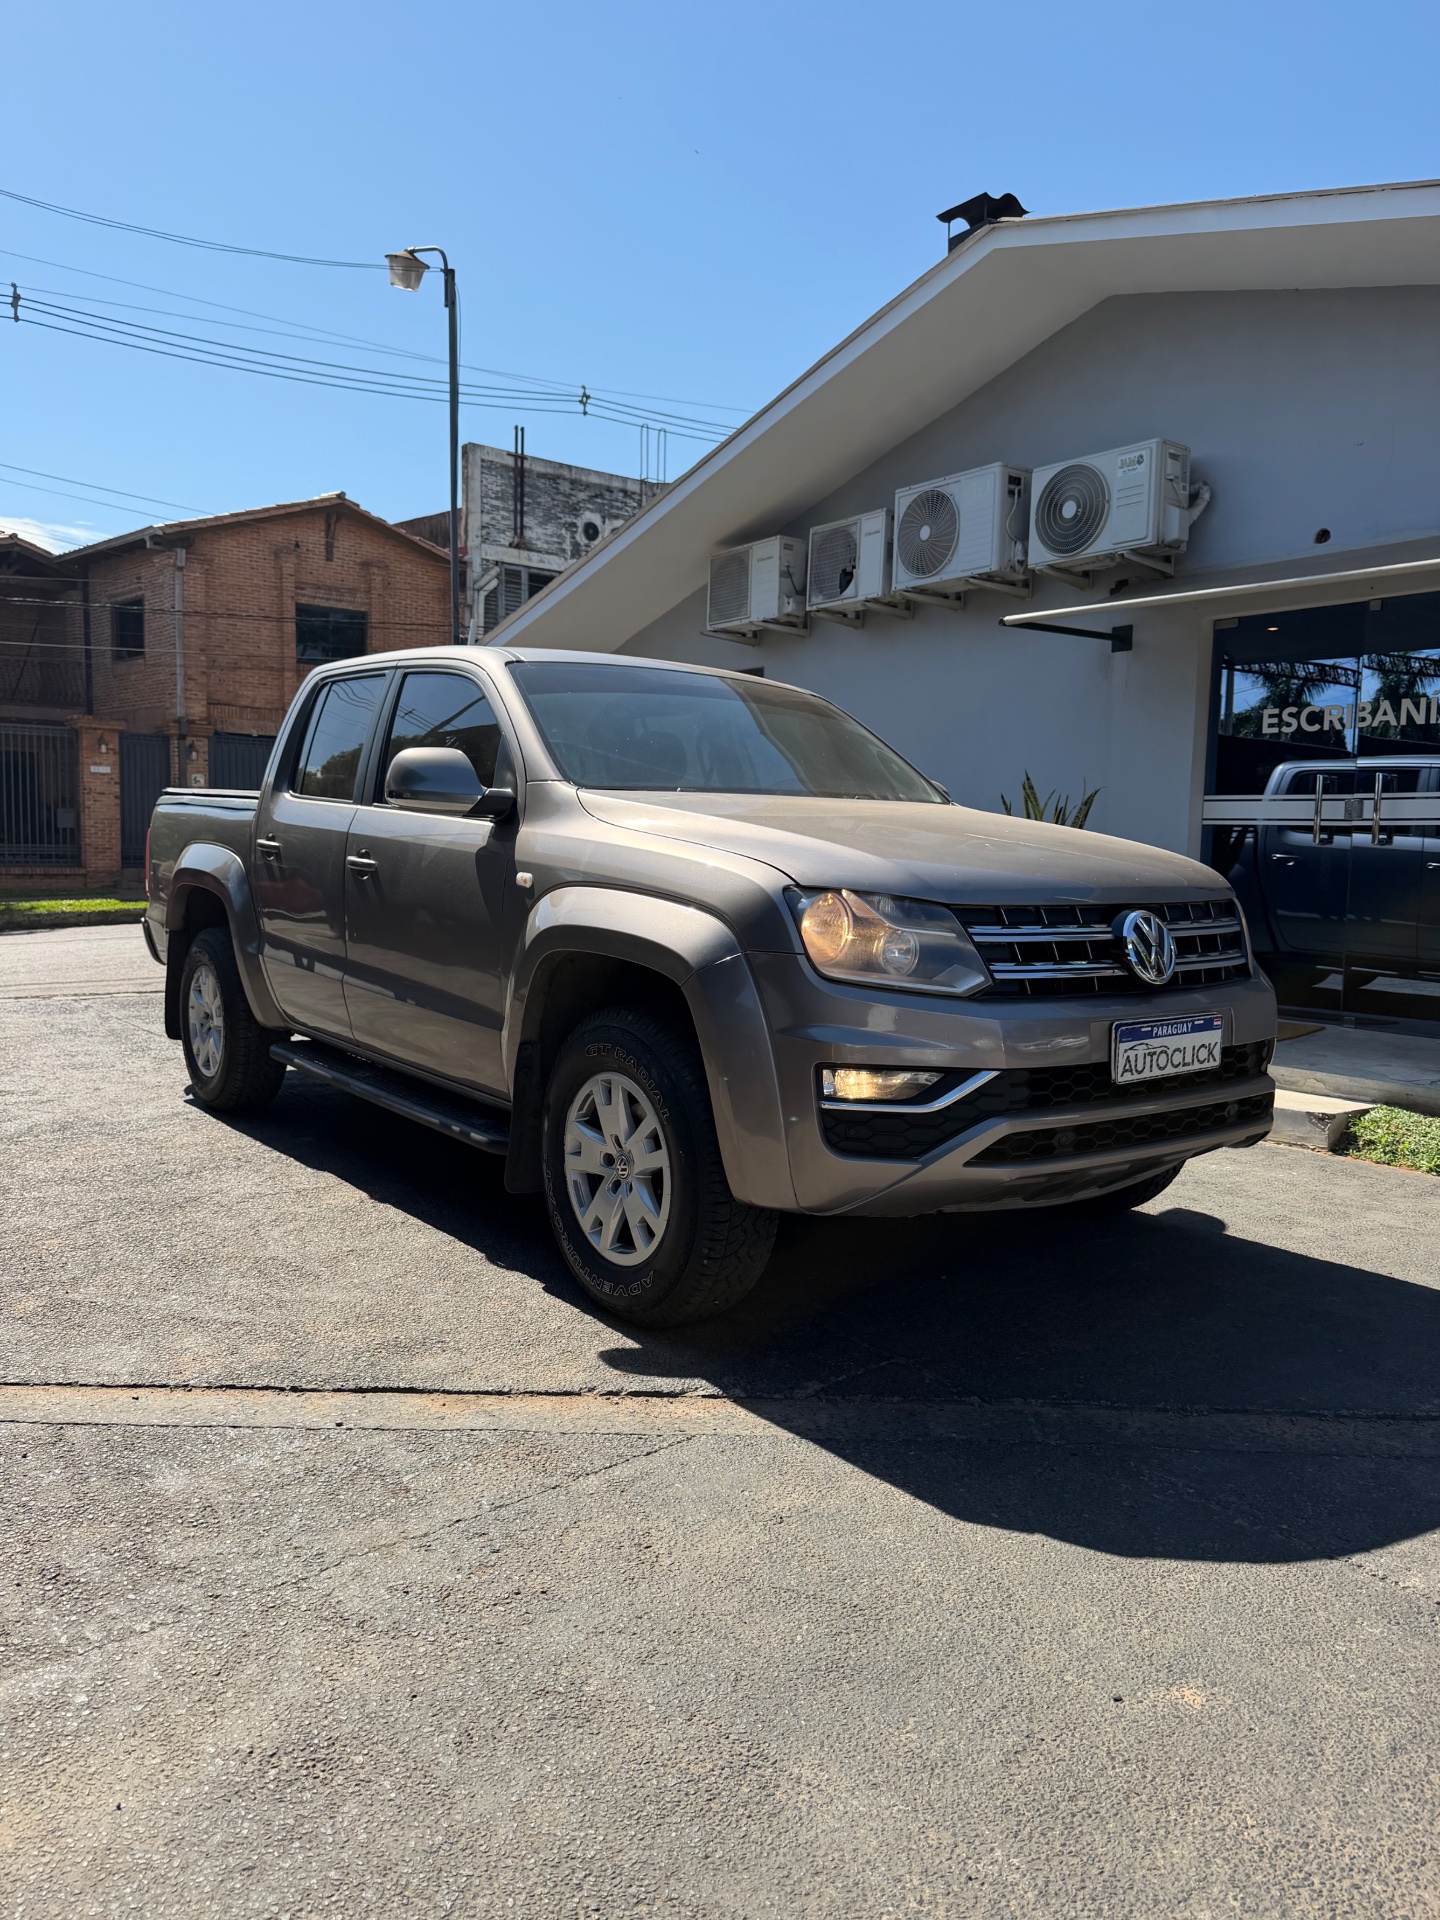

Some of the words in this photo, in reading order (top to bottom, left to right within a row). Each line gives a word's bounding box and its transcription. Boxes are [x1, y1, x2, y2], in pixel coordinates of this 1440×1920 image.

[1261, 690, 1440, 734] ESCRIBANÍ
[1152, 1022, 1193, 1037] PARAGUAY
[1120, 1041, 1219, 1078] AUTOCLICK
[584, 1043, 612, 1057] GT
[614, 1046, 670, 1125] RADIAL
